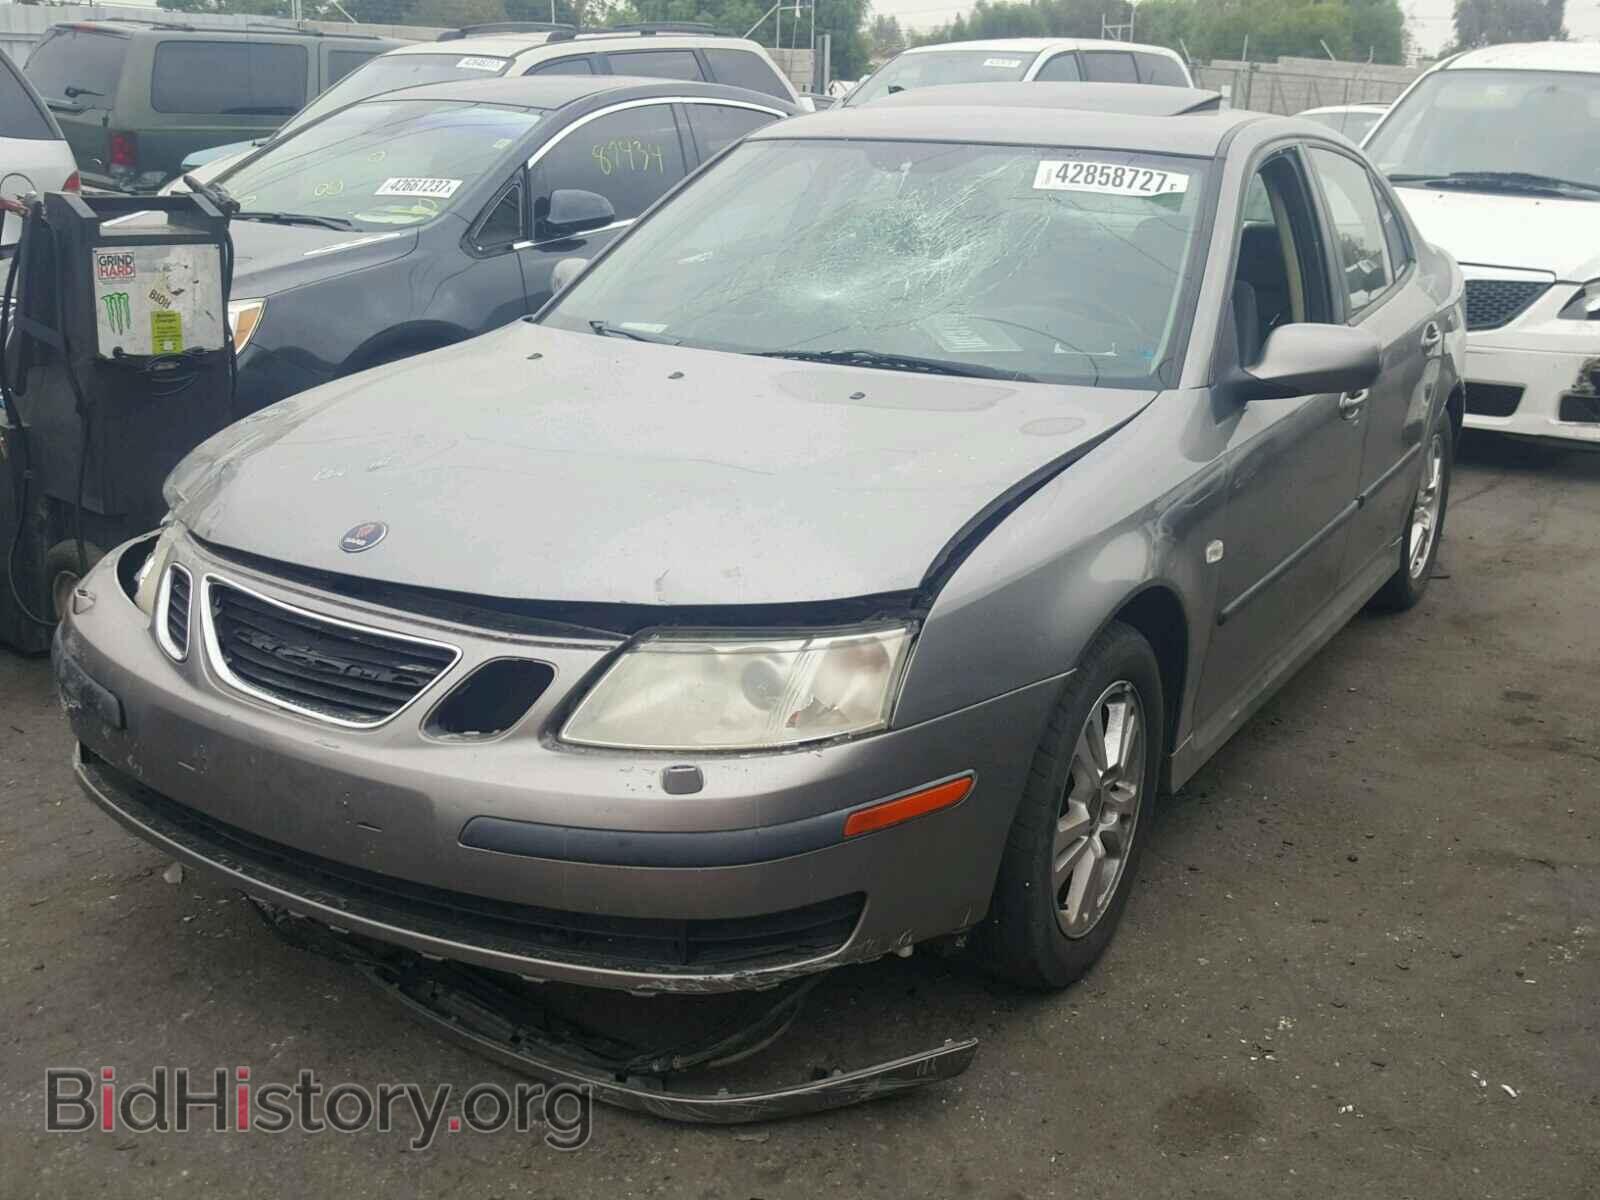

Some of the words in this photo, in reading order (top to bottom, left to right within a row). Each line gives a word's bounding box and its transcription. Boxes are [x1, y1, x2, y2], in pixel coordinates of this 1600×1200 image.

[1055, 163, 1168, 193] 42858727
[390, 179, 450, 192] 42661237
[99, 255, 133, 266] GRIND
[99, 265, 133, 277] HARD
